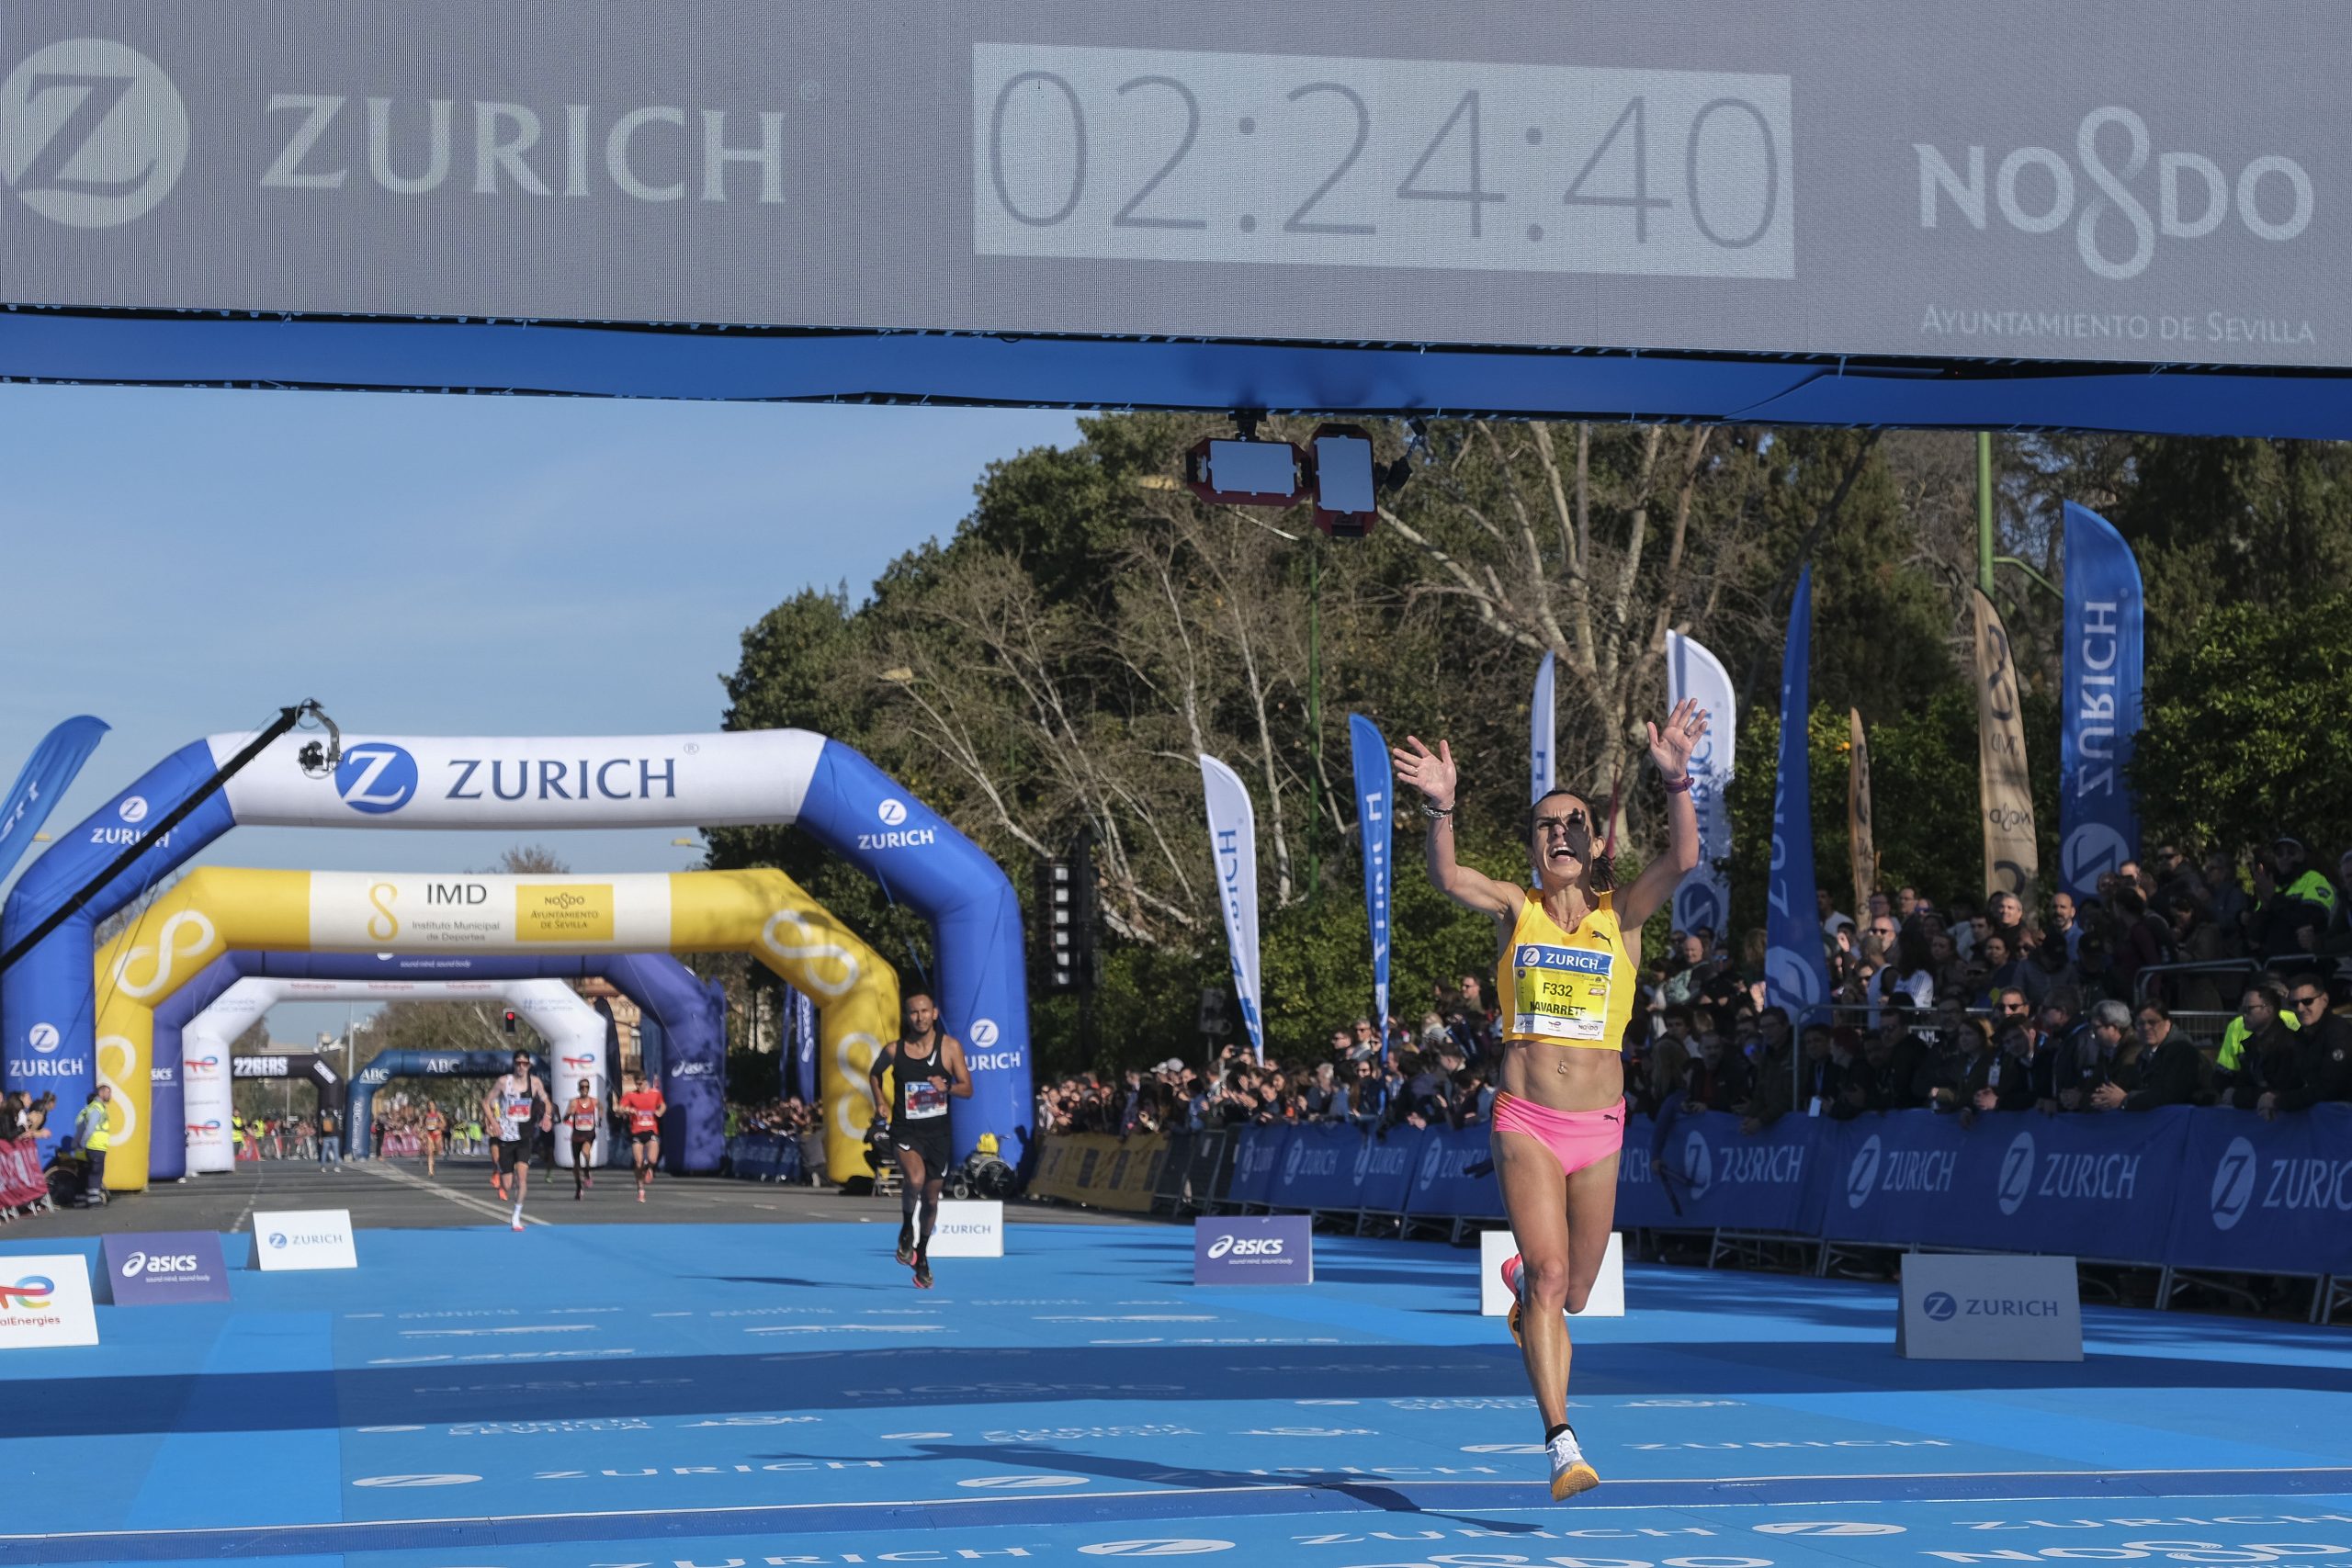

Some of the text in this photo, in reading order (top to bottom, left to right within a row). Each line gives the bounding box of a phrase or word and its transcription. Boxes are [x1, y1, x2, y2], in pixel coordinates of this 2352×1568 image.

[260, 93, 786, 204] ZURICH
[989, 69, 1779, 250] 02:24:40
[2160, 314, 2199, 342] DE
[2208, 310, 2316, 345] SEVILLA
[445, 758, 676, 801] ZURICH
[90, 827, 171, 849] ZURIH
[857, 829, 934, 851] ZURICH
[426, 883, 487, 905] IMD
[412, 919, 500, 932] Instituto Municipal
[1544, 953, 1600, 970] ZURICH
[1543, 982, 1574, 998] F332
[9, 1057, 84, 1077] ZURICH
[233, 1056, 288, 1077] 226ERS
[425, 1058, 460, 1074] ABC
[965, 1050, 1022, 1072] URICH
[359, 1067, 390, 1081] ABC
[1720, 1145, 1804, 1183] ZURICH
[1882, 1149, 1958, 1192] ZURICH
[2037, 1153, 2142, 1200] ZURICH
[941, 1224, 992, 1235] ZURICH
[291, 1233, 343, 1247] ZURICH
[1965, 1298, 2059, 1318] ZURICH
[1621, 1439, 1952, 1450] ZURICH
[532, 1460, 886, 1480] ZURICH
[1951, 1515, 2352, 1530] ZURICH
[1290, 1528, 1720, 1545] ZURICH
